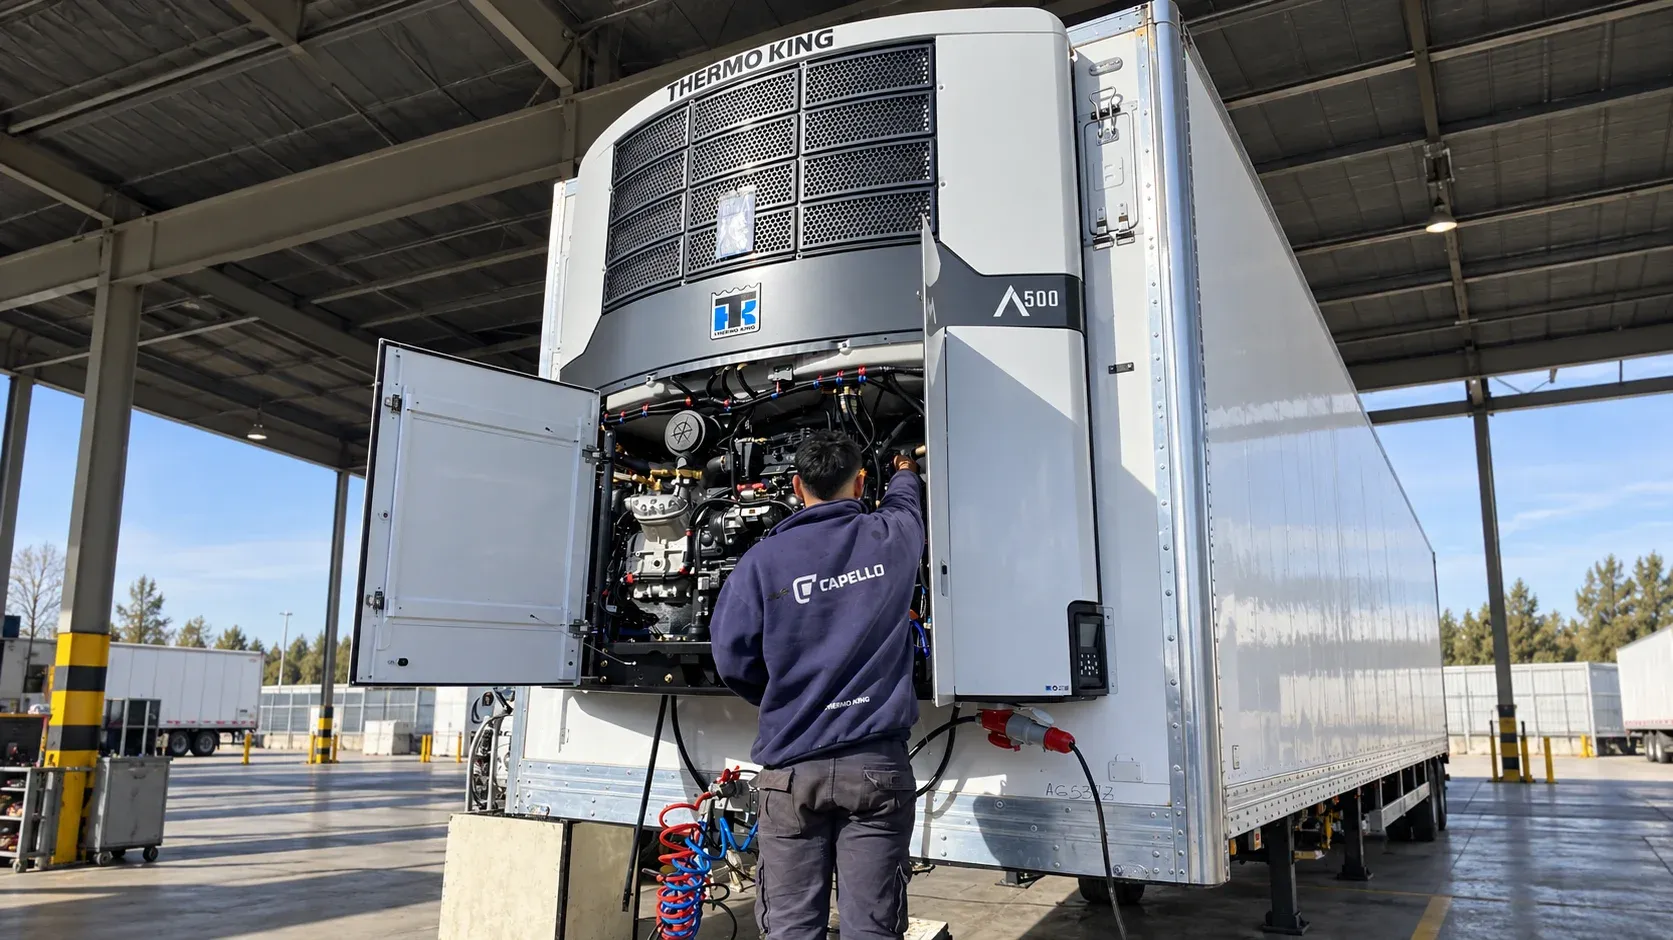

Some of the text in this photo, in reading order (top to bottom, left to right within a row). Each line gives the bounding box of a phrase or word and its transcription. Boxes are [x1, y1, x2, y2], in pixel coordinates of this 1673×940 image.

[667, 28, 834, 102] THERMO KING
[819, 563, 885, 592] CAPELLO
